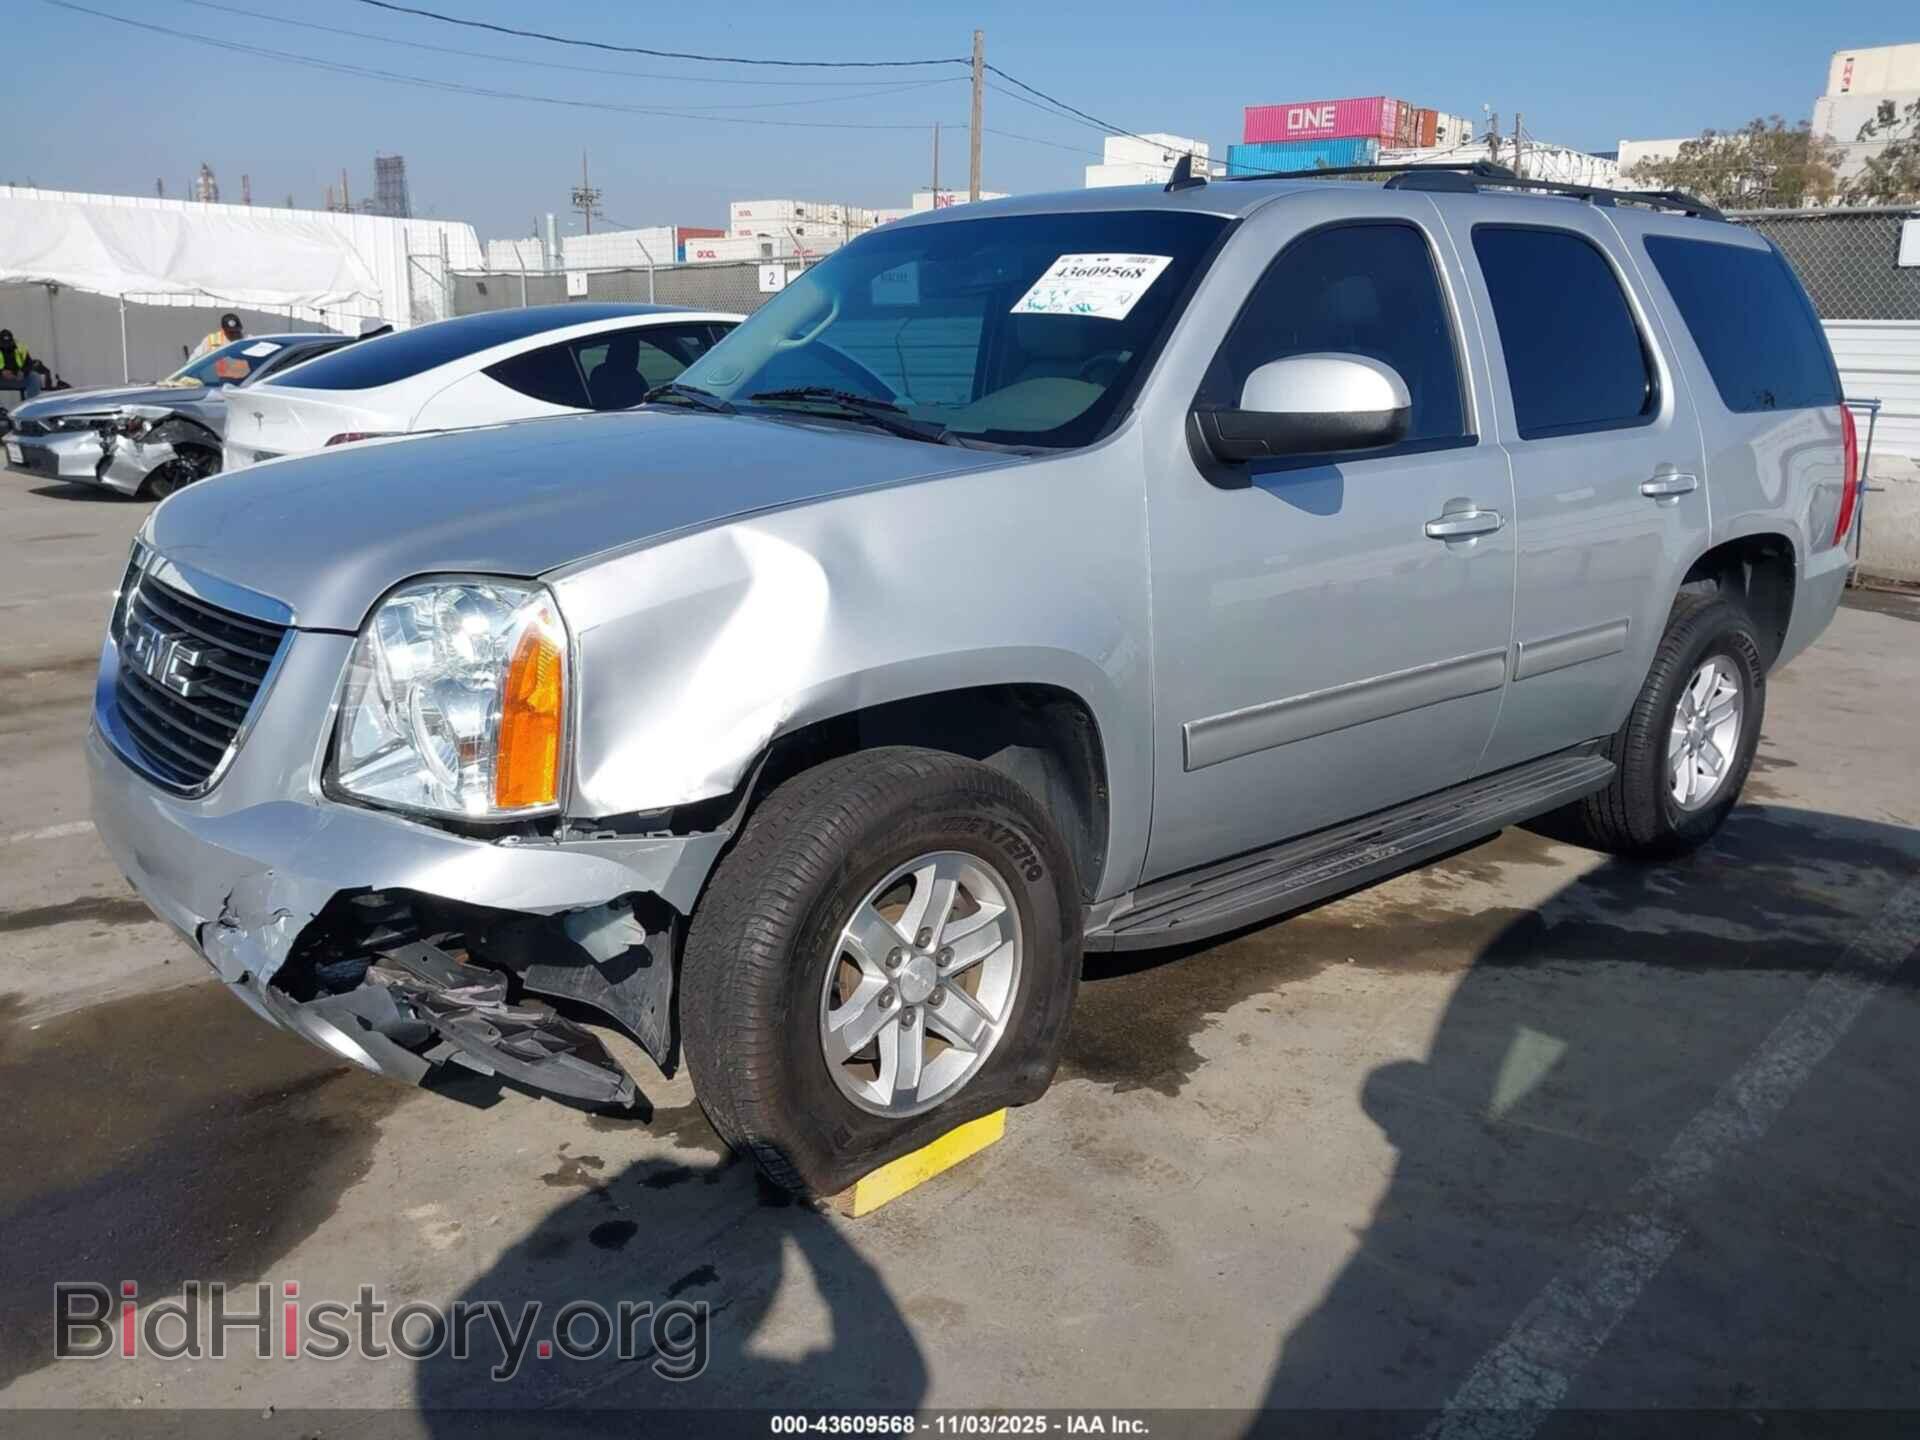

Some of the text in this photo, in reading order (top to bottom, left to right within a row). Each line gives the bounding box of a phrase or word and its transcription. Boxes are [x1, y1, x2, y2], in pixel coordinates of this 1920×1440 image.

[1287, 105, 1336, 130] ONE
[768, 271, 776, 286] 2
[1055, 265, 1146, 279] 43609568
